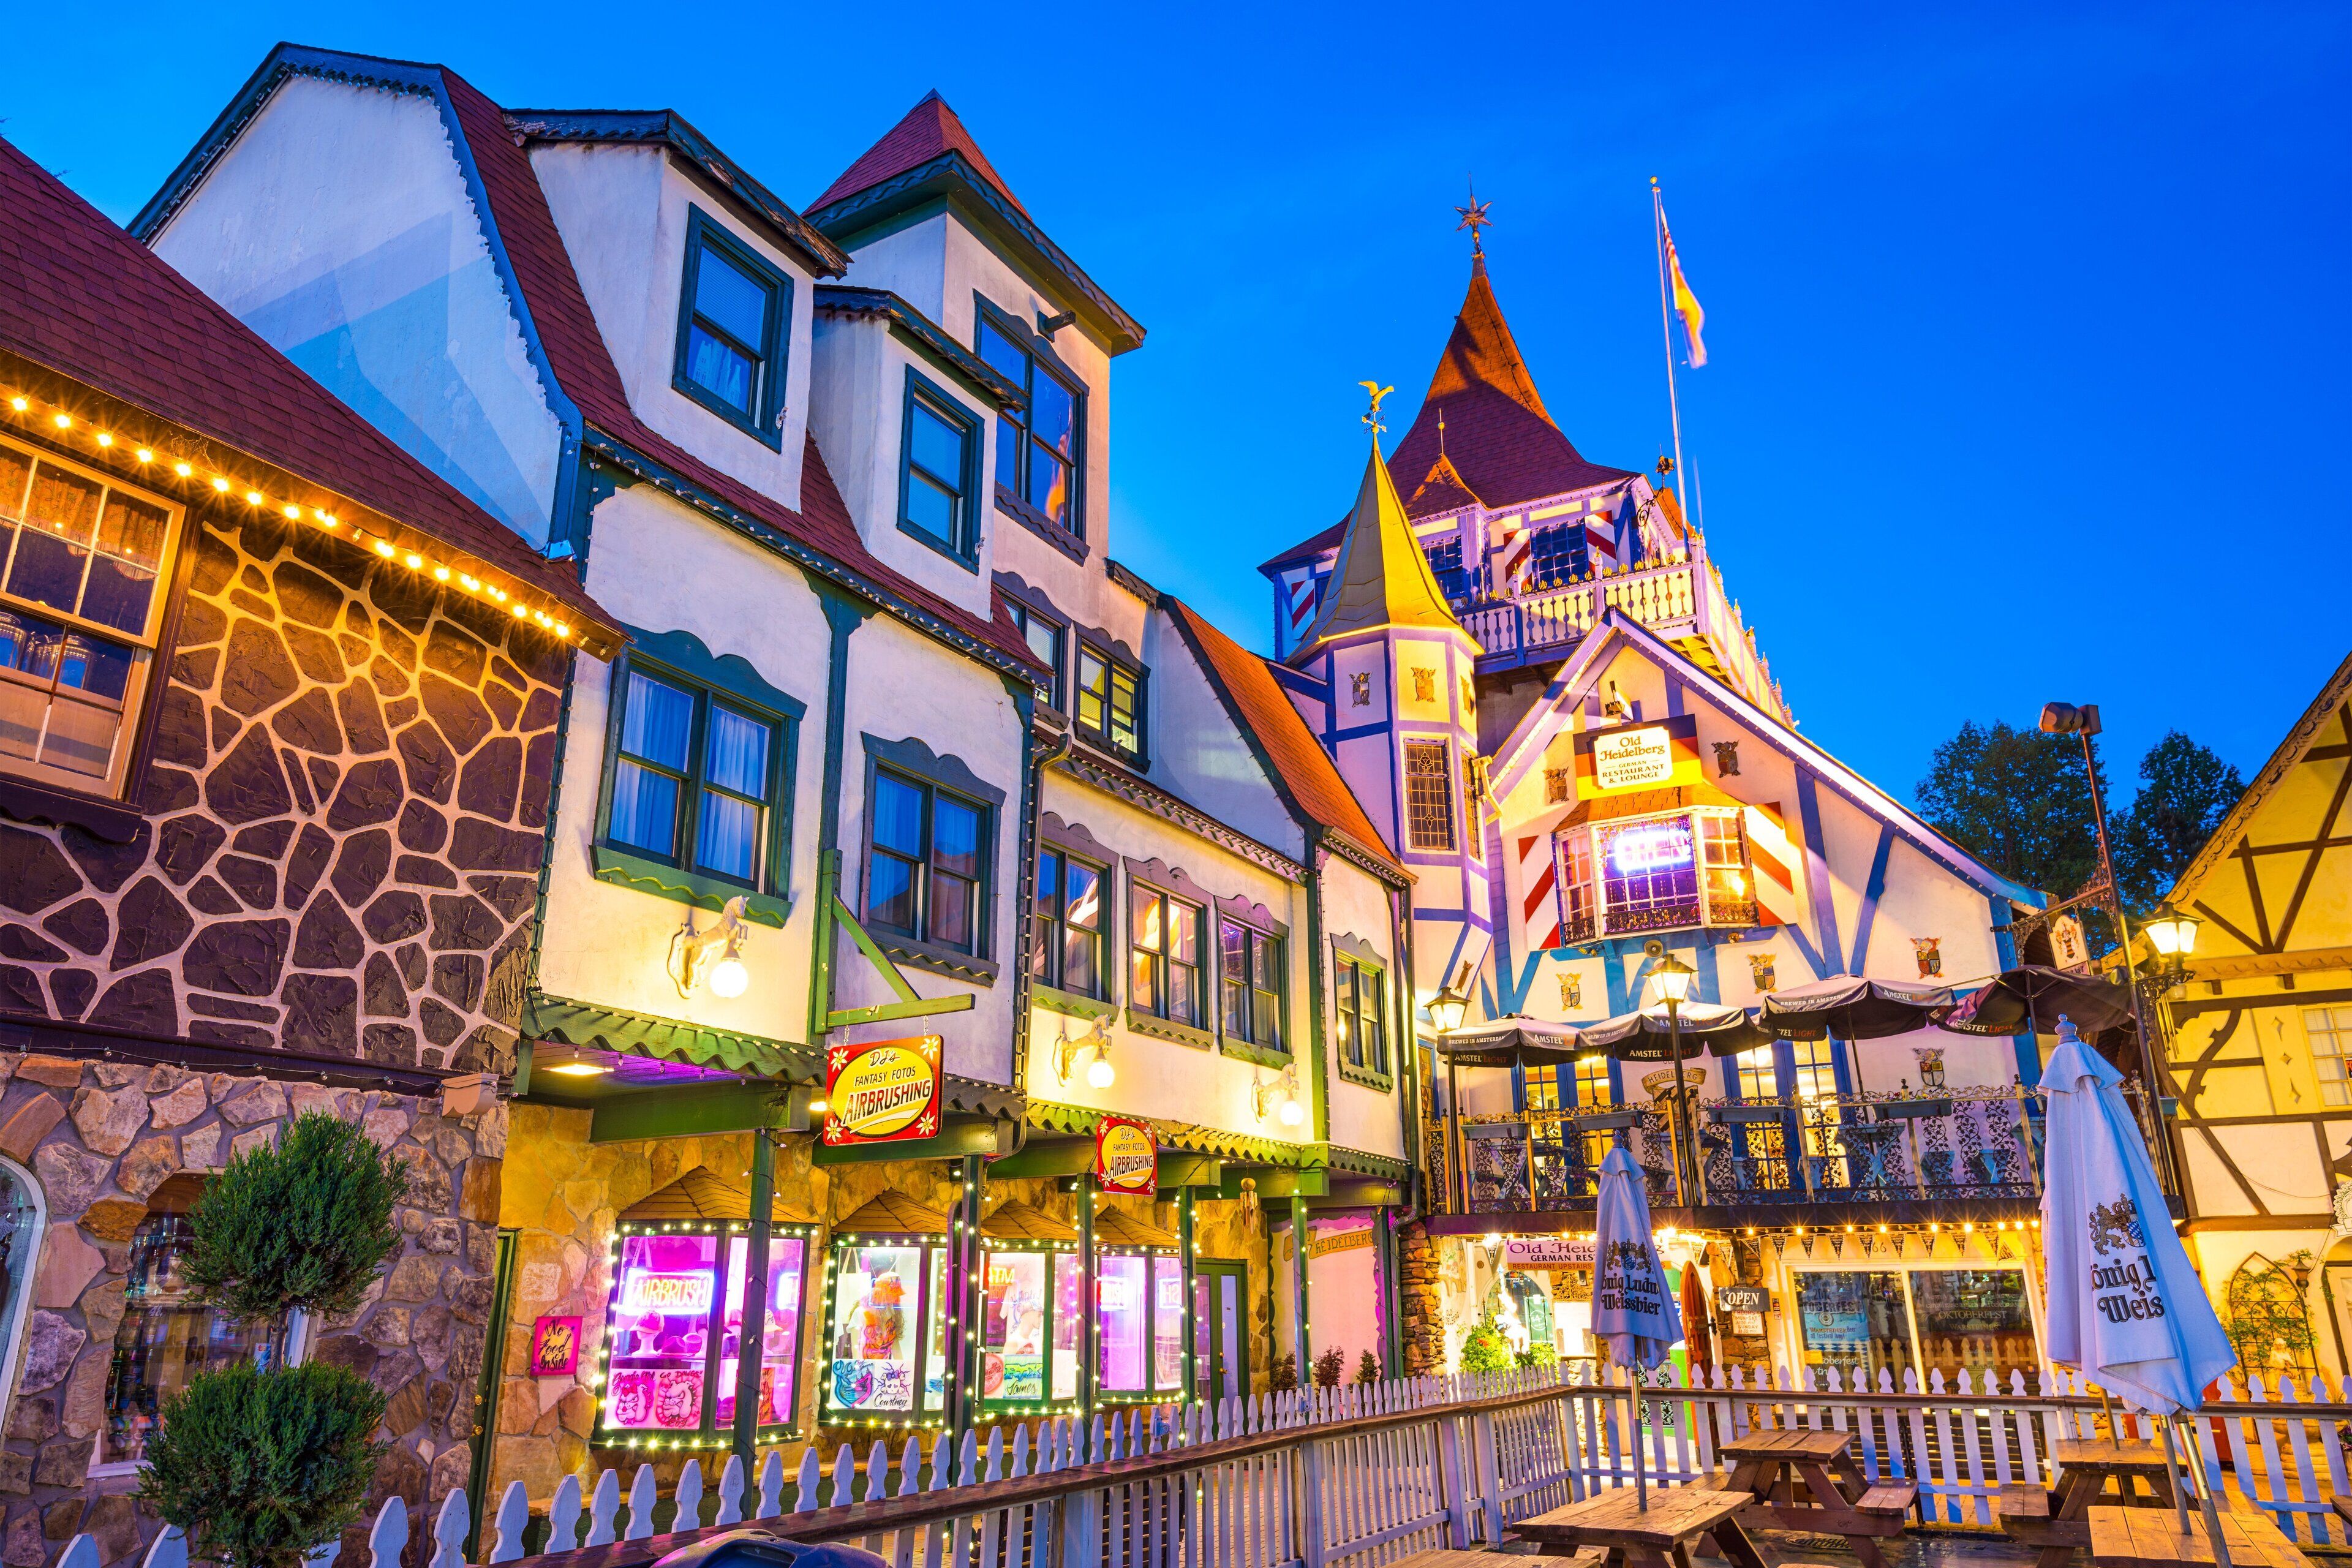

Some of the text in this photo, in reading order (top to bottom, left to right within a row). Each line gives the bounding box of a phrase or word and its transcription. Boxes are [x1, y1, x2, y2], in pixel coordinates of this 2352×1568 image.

[1619, 736, 1642, 747] Old
[1600, 745, 1665, 761] Heidelberg
[1602, 764, 1664, 777] RESTAURANT
[1621, 772, 1659, 782] LOUNGE
[1884, 989, 1911, 1001] AMSTEL
[1534, 1035, 1563, 1044] AMSTEL
[869, 1049, 900, 1066] DJ's
[1664, 1048, 1692, 1057] LIHT
[855, 1066, 916, 1087] FANTASY FOTOS
[1648, 1071, 1697, 1084] HEIDELERG
[842, 1079, 930, 1125] AIRBRUSHING
[1120, 1128, 1135, 1140] DJ's
[1109, 1155, 1153, 1178] AIRBRUSHING
[1509, 1243, 1542, 1253] Old
[2091, 1258, 2141, 1294] önig
[633, 1278, 708, 1306] AIRBRUSH
[1727, 1290, 1760, 1305] OPEN
[1600, 1292, 1661, 1316] Weissbier
[1803, 1300, 1862, 1313] TOBERFEST
[2097, 1290, 2165, 1324] Weis
[1938, 1310, 2007, 1319] OKTOBERFEST
[545, 1317, 568, 1337] No
[538, 1333, 572, 1355] Food
[539, 1352, 569, 1371] Inside
[1822, 1355, 1860, 1366] oberfest
[1006, 1379, 1036, 1396] James
[873, 1393, 908, 1409] Courtney
